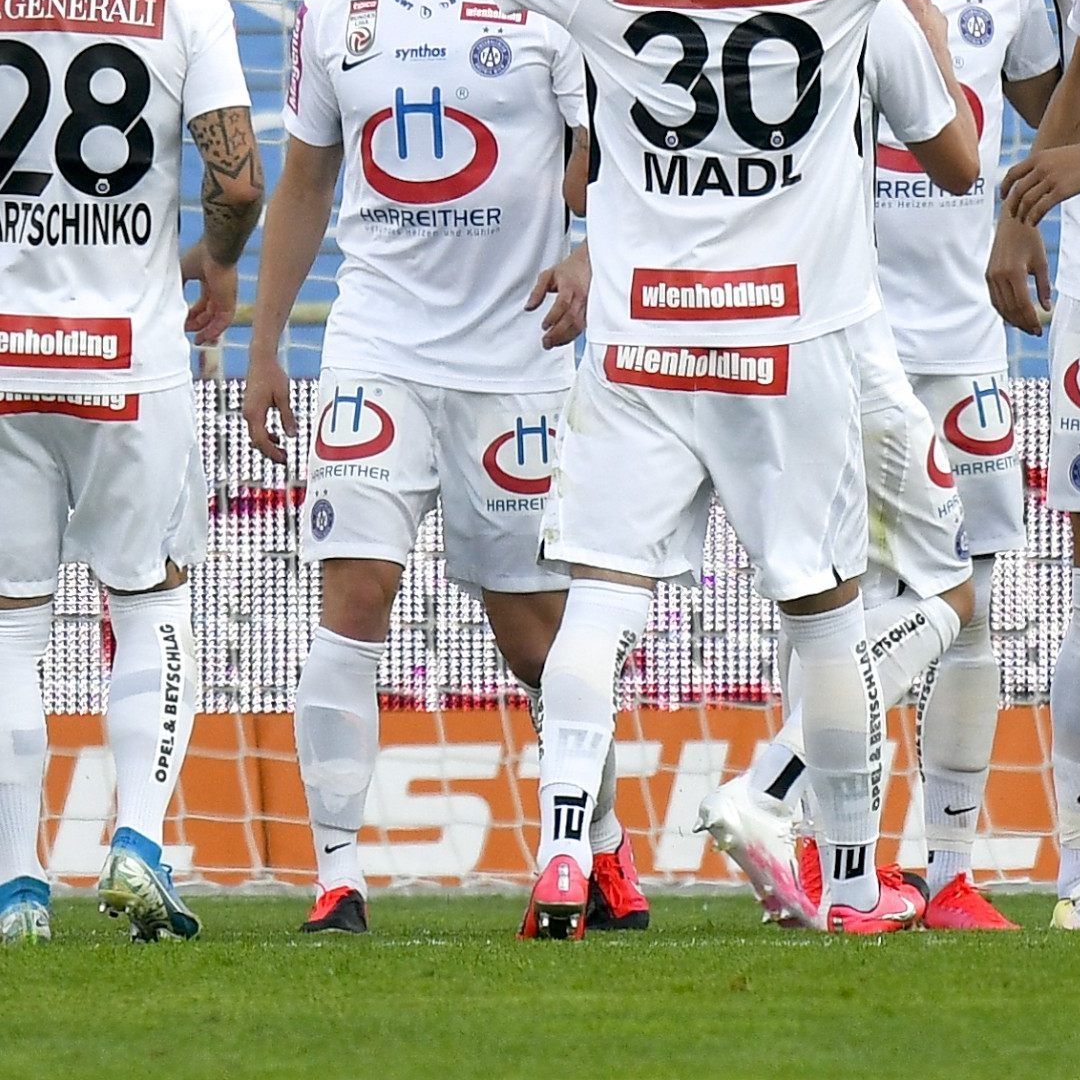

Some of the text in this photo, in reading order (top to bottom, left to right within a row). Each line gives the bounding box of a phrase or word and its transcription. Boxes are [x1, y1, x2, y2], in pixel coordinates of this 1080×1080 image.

[394, 43, 447, 62] synthos
[622, 10, 825, 151] 30
[644, 151, 802, 198] MADL
[0, 201, 152, 247] RTSCHINKO
[360, 207, 502, 228] HARREITHER
[159, 623, 182, 716] BEYSCHLAG
[155, 736, 175, 783] OPEL
